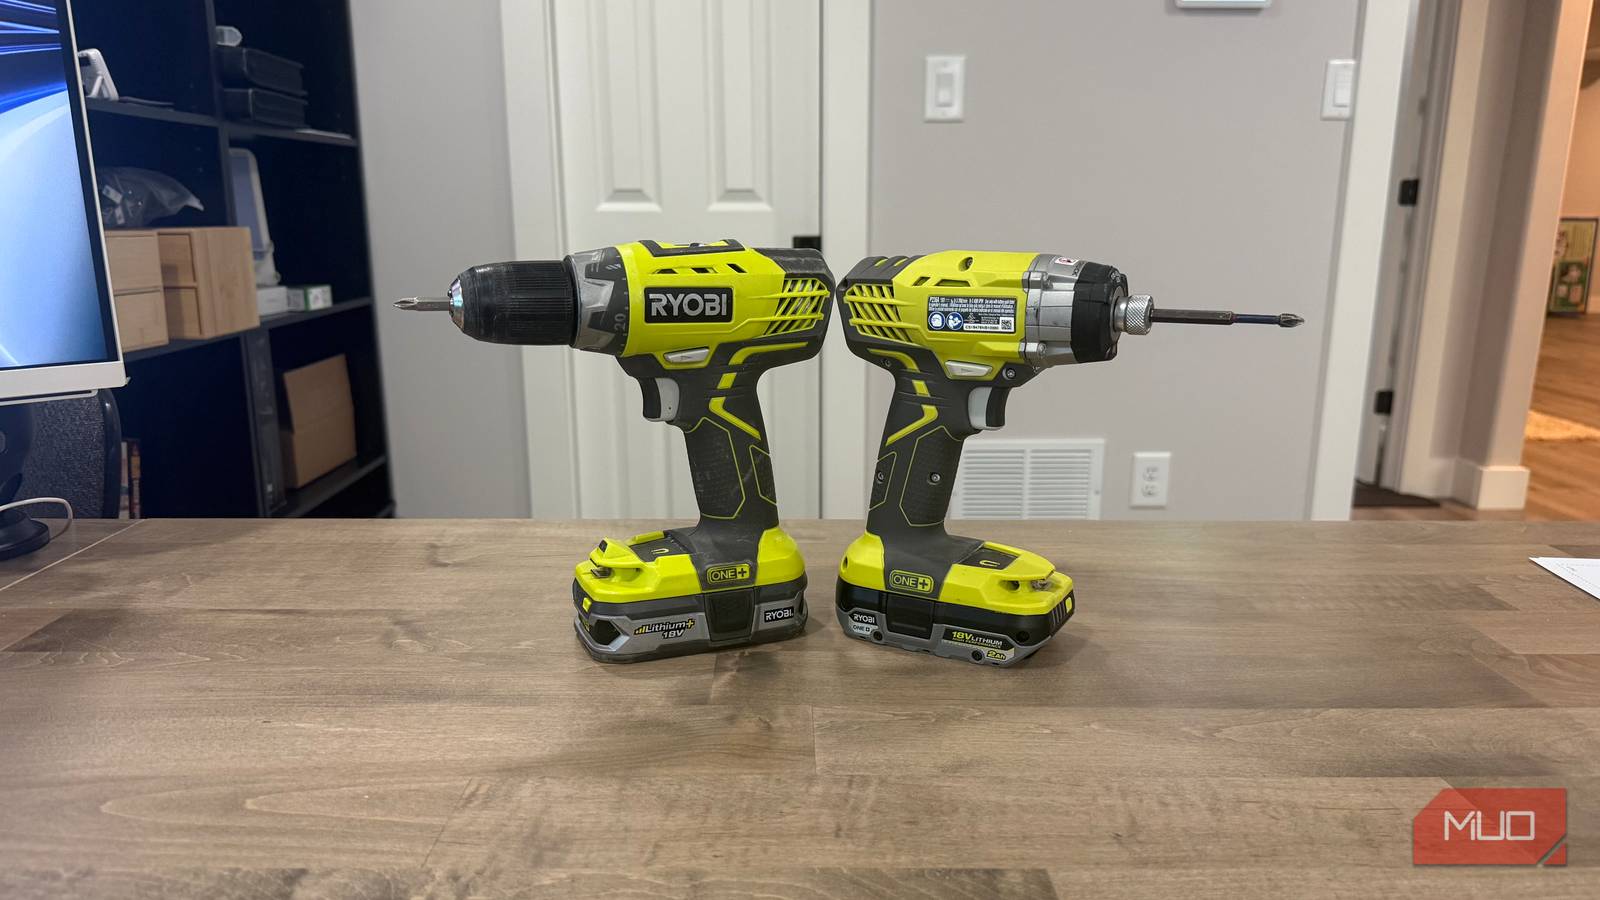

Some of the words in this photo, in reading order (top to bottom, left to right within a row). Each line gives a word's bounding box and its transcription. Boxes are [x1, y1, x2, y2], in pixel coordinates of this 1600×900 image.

[649, 293, 727, 317] RYOBI
[765, 609, 794, 621] RYOBI
[853, 613, 875, 624] RYOBI
[662, 629, 684, 638] 18V
